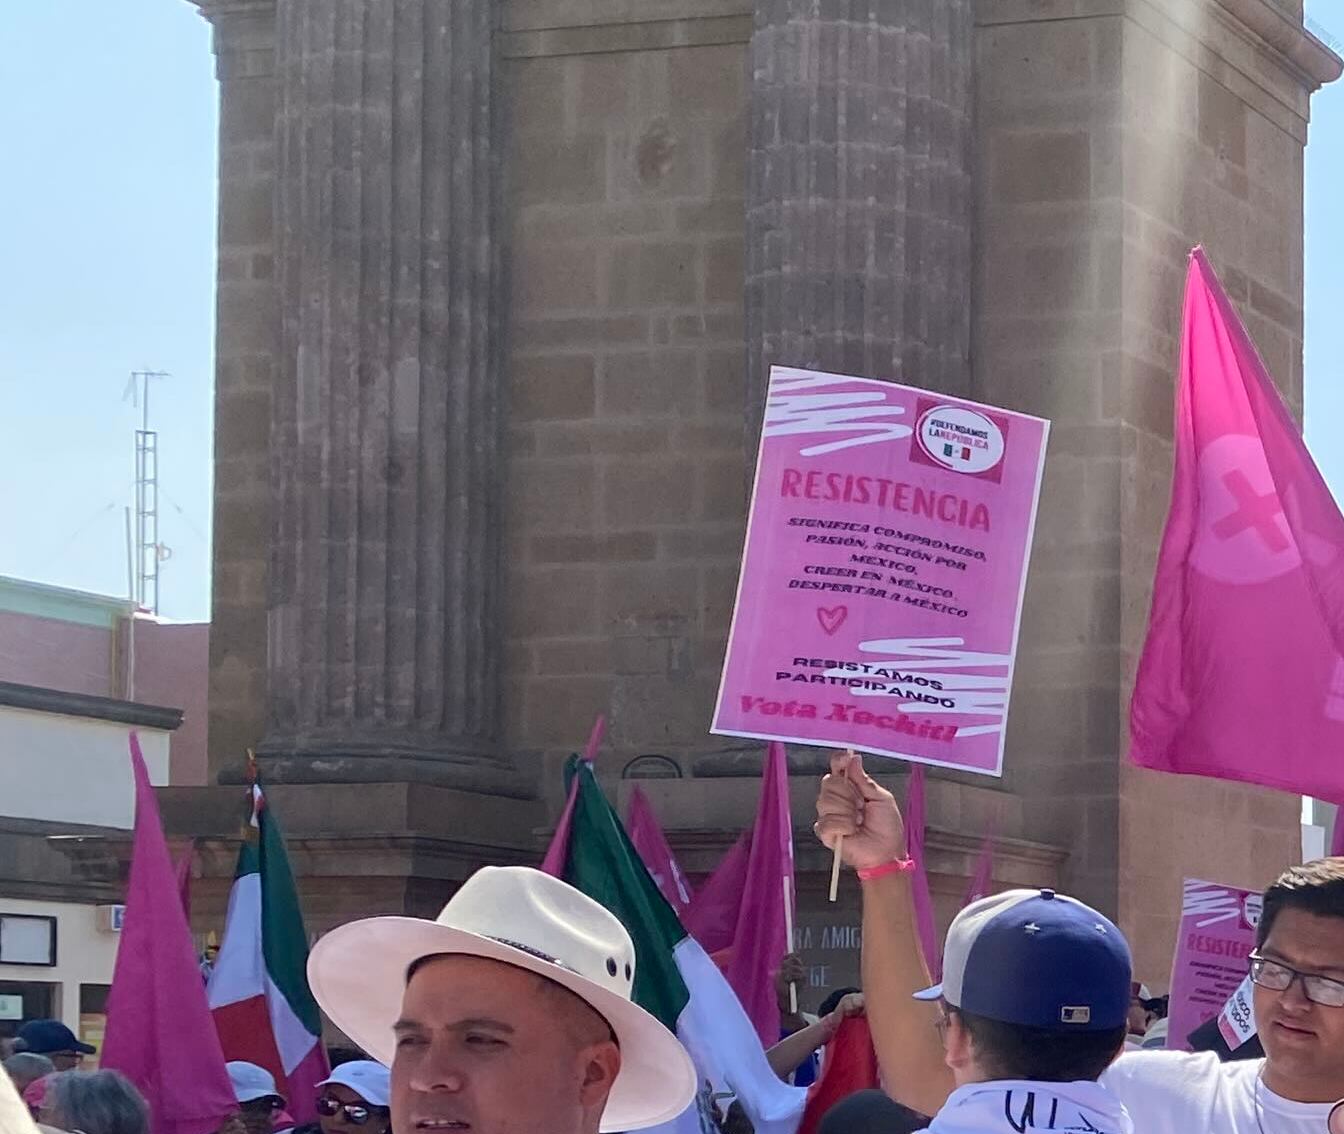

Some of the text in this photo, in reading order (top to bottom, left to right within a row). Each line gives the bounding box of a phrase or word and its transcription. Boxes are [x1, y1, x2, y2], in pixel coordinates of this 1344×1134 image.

[780, 467, 990, 532] RESISTENCIA
[787, 517, 870, 533] SIGNIFICA
[804, 565, 858, 578] CREER
[860, 571, 883, 581] EN
[935, 556, 968, 572] POR
[788, 579, 887, 599] DESPERTAR
[889, 592, 901, 601] A
[792, 657, 944, 690] RESISTAMOS
[776, 671, 955, 709] PARTICIPANDO
[741, 695, 817, 719] Vota
[821, 926, 861, 949] AMIG
